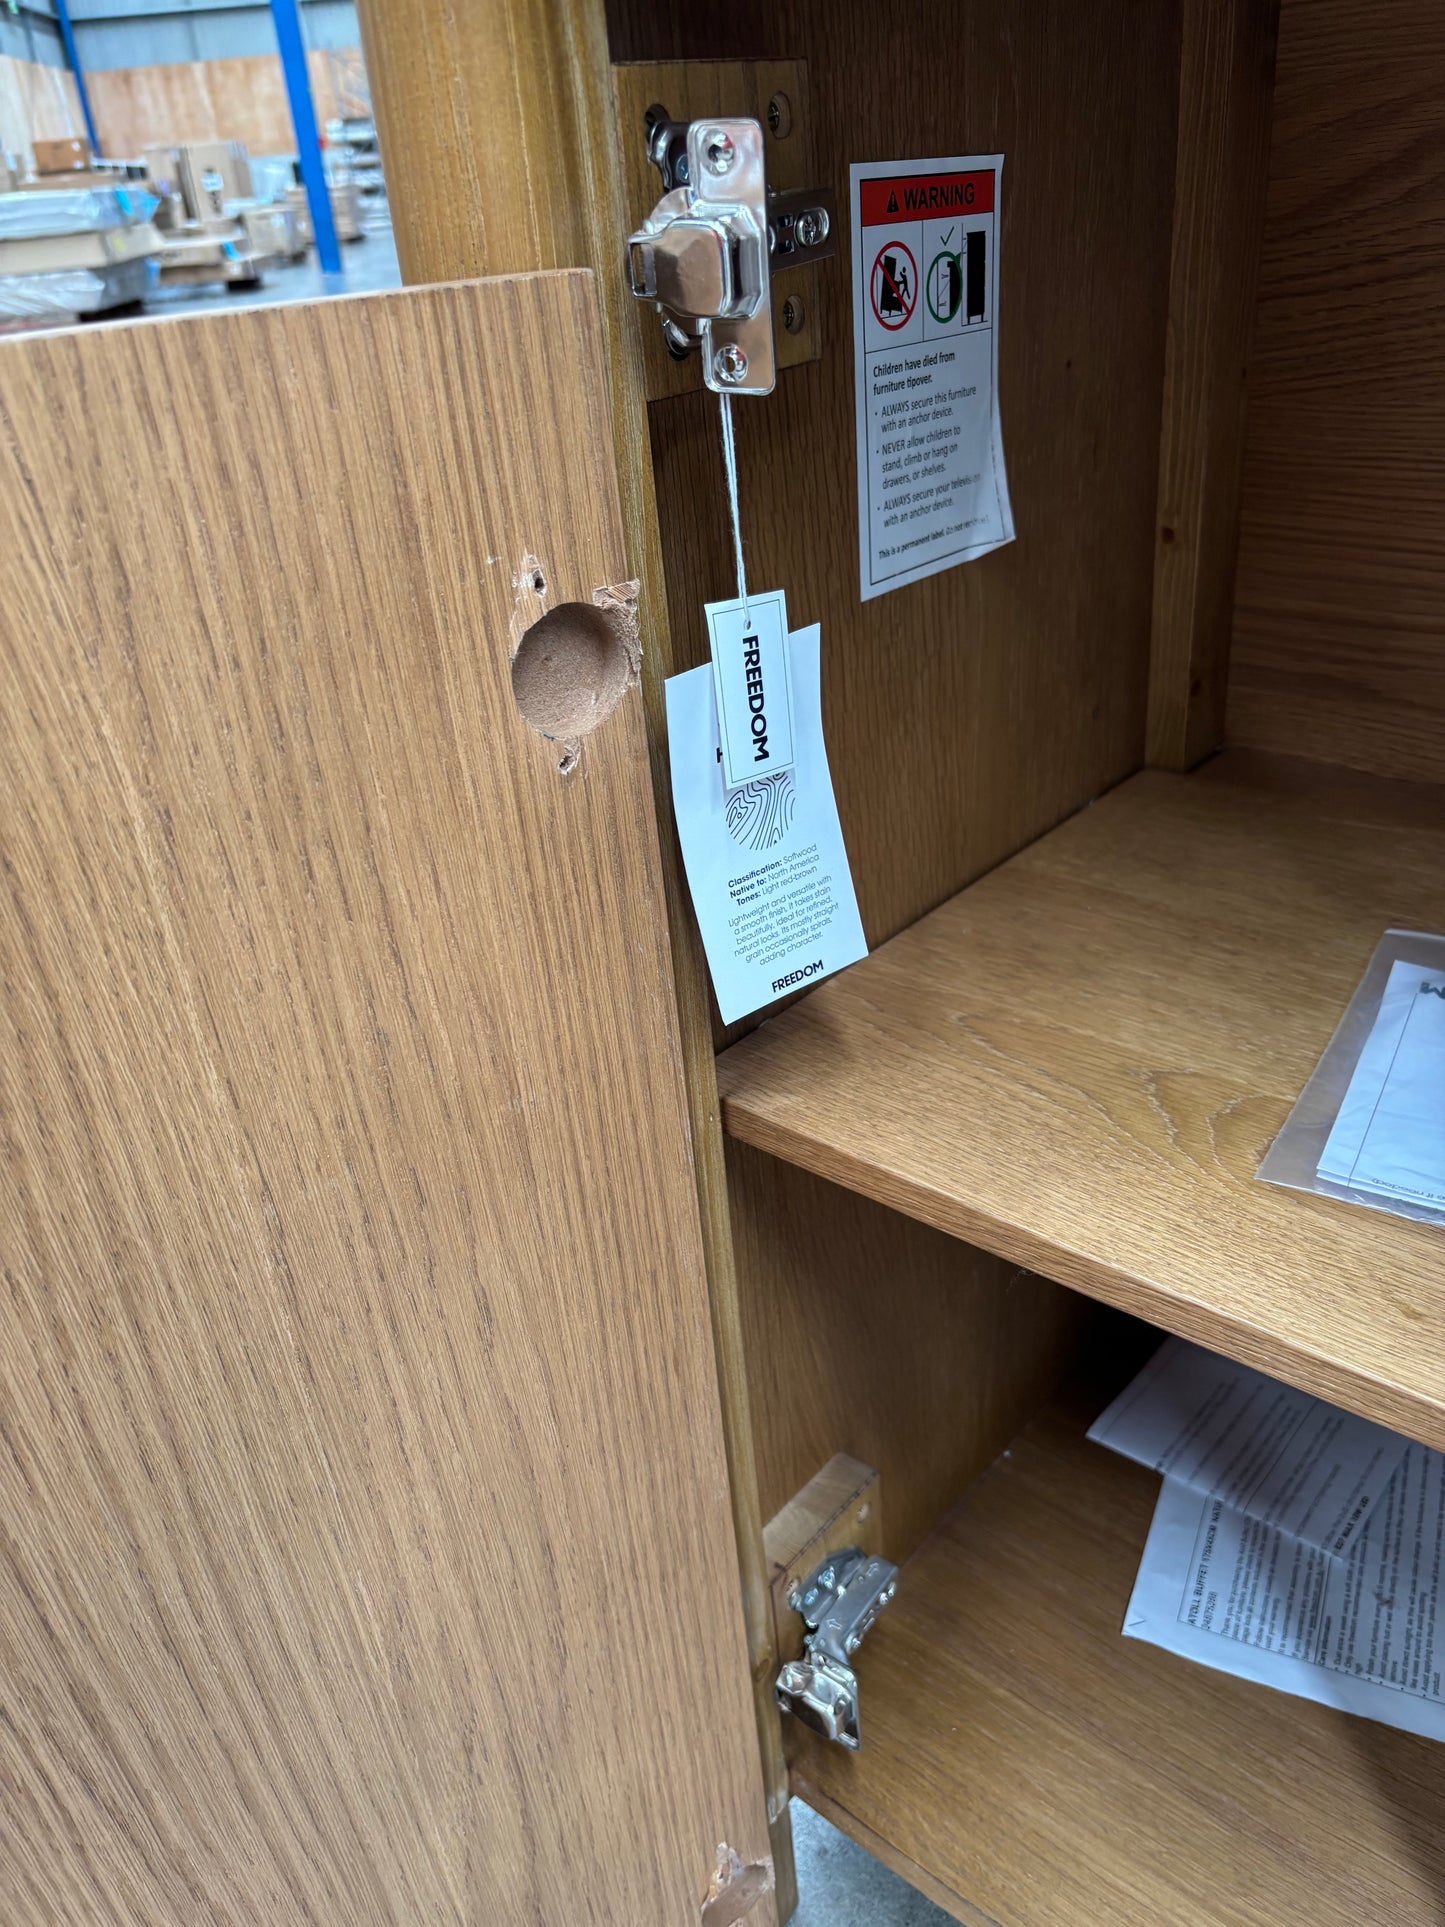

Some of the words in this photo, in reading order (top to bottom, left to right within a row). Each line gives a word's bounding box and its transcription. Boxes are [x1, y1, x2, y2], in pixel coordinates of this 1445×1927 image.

[903, 182, 975, 211] WARNING
[873, 364, 903, 377] Children
[904, 360, 921, 370] have
[922, 353, 937, 366] died
[939, 352, 955, 362] from
[873, 381, 905, 395] furniture
[906, 375, 932, 389] tipover.
[881, 401, 909, 417] ALWAYS
[911, 398, 933, 410] secure
[934, 393, 946, 404] this
[948, 387, 976, 400] furniture
[881, 420, 896, 432] with
[897, 420, 906, 428] an
[907, 413, 930, 426] anchor
[931, 408, 953, 419] device.
[881, 440, 905, 455] NEVER
[906, 436, 924, 448] allow
[926, 429, 952, 443] children
[953, 427, 960, 435] to
[881, 458, 902, 473] stand,
[903, 453, 922, 466] climb
[923, 452, 930, 460] or
[931, 446, 948, 457] hang
[949, 444, 957, 453] on
[882, 475, 911, 489] drawers,
[912, 471, 920, 480] or
[921, 464, 945, 478] shelves.
[883, 494, 911, 510] ALWAYS
[912, 489, 933, 502] secure
[934, 483, 950, 495] your
[883, 515, 898, 527] with
[900, 513, 908, 522] an
[909, 505, 931, 519] anchor
[932, 498, 953, 511] device.
[878, 550, 890, 558] This
[901, 535, 929, 551] permanent
[742, 635, 770, 763] FREEDOM
[728, 861, 782, 887] Classification:
[783, 844, 817, 863] Softwood
[729, 884, 754, 898] Native
[756, 878, 766, 886] to:
[767, 868, 788, 881] North
[789, 855, 819, 872] America
[736, 892, 761, 905] Tones:
[761, 882, 779, 895] Light
[780, 866, 817, 886] red-brown
[728, 903, 769, 927] Lightweight
[770, 895, 786, 907] and
[786, 883, 815, 899] versatile
[816, 876, 831, 886] with
[740, 916, 768, 932] smooth
[768, 907, 787, 918] finish.
[794, 895, 813, 906] takes
[814, 887, 831, 898] stain
[734, 939, 759, 956] natural
[759, 931, 780, 944] looks.
[780, 926, 789, 934] Its
[790, 916, 812, 930] mostly
[813, 903, 838, 919] straight
[735, 924, 774, 944] beautifully.
[775, 912, 794, 926] Ideal
[794, 909, 805, 917] for
[745, 949, 764, 963] grain
[764, 928, 808, 952] occasionally
[759, 949, 785, 965] adding
[786, 932, 823, 952] character.
[771, 959, 824, 993] FREEDOM
[1193, 1565, 1207, 1595] BUFFET
[1188, 1600, 1200, 1624] ATOLL
